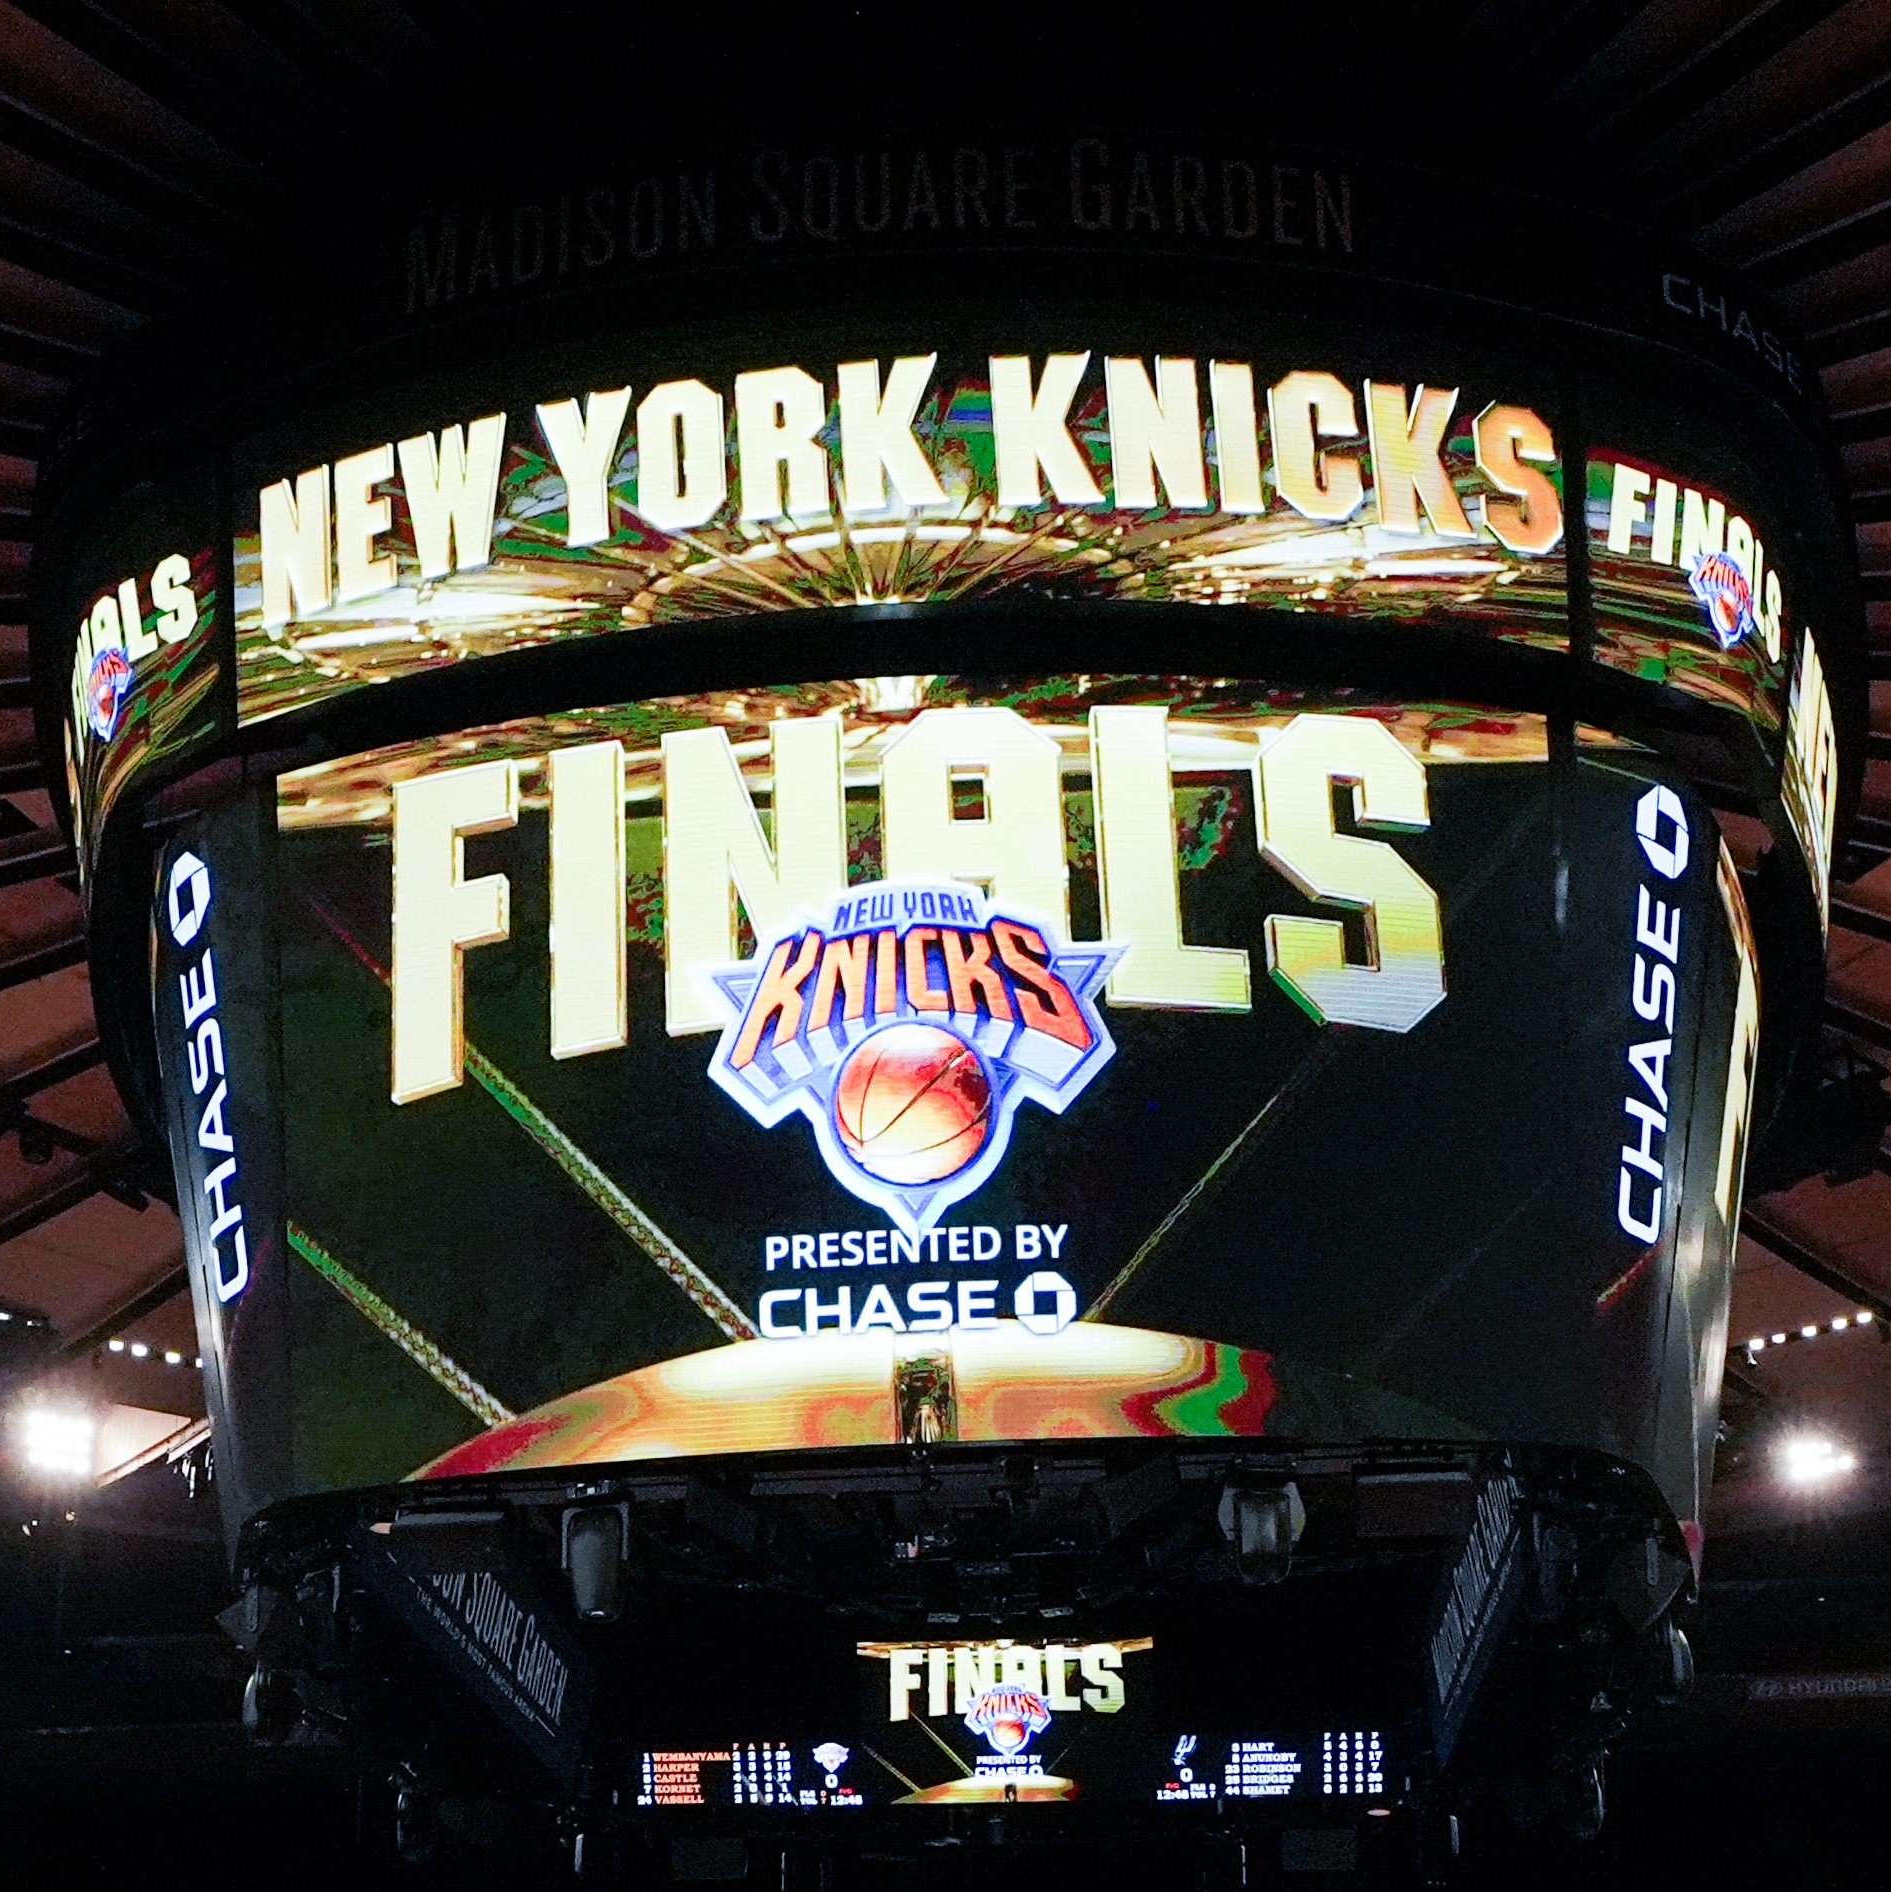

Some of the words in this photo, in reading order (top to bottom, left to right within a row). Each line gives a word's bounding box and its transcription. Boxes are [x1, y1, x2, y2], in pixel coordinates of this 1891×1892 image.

[405, 170, 713, 316] MADISON
[749, 147, 1038, 244] SQUARE
[1069, 134, 1356, 254] GARDEN
[257, 411, 509, 643] NEW
[536, 351, 950, 550] YORK
[987, 349, 1565, 558] KNICKS
[391, 704, 1449, 1106] FINALS
[832, 890, 895, 932] NEW
[901, 885, 978, 925] YORK
[728, 912, 1094, 1070] KNICKS
[1616, 883, 1682, 1246] CHASE
[178, 947, 252, 1303] CHASE
[763, 1222, 1002, 1272] PRESENTED
[1015, 1222, 1070, 1264] BY
[757, 1277, 1001, 1339] CHASE
[517, 1614, 569, 1726] GARDEN
[889, 1643, 1126, 1722] FINALS
[1242, 1742, 1275, 1752] HART
[652, 1752, 731, 1762] WEMBANYAMA
[976, 1755, 1027, 1765] PRESENTED
[1029, 1755, 1042, 1764] BY
[1242, 1753, 1297, 1763] ANUNOBY
[653, 1763, 700, 1772] HARPER
[974, 1766, 1026, 1778] CHASE
[1242, 1764, 1302, 1773] ROBINSON
[654, 1773, 698, 1783] CASTLE
[825, 1774, 838, 1788] 0
[1180, 1768, 1193, 1782] 0
[1242, 1774, 1294, 1784] BRIDGES
[654, 1784, 701, 1794] KORNET
[1242, 1785, 1292, 1795] SHAMET
[654, 1794, 704, 1804] VASSELL
